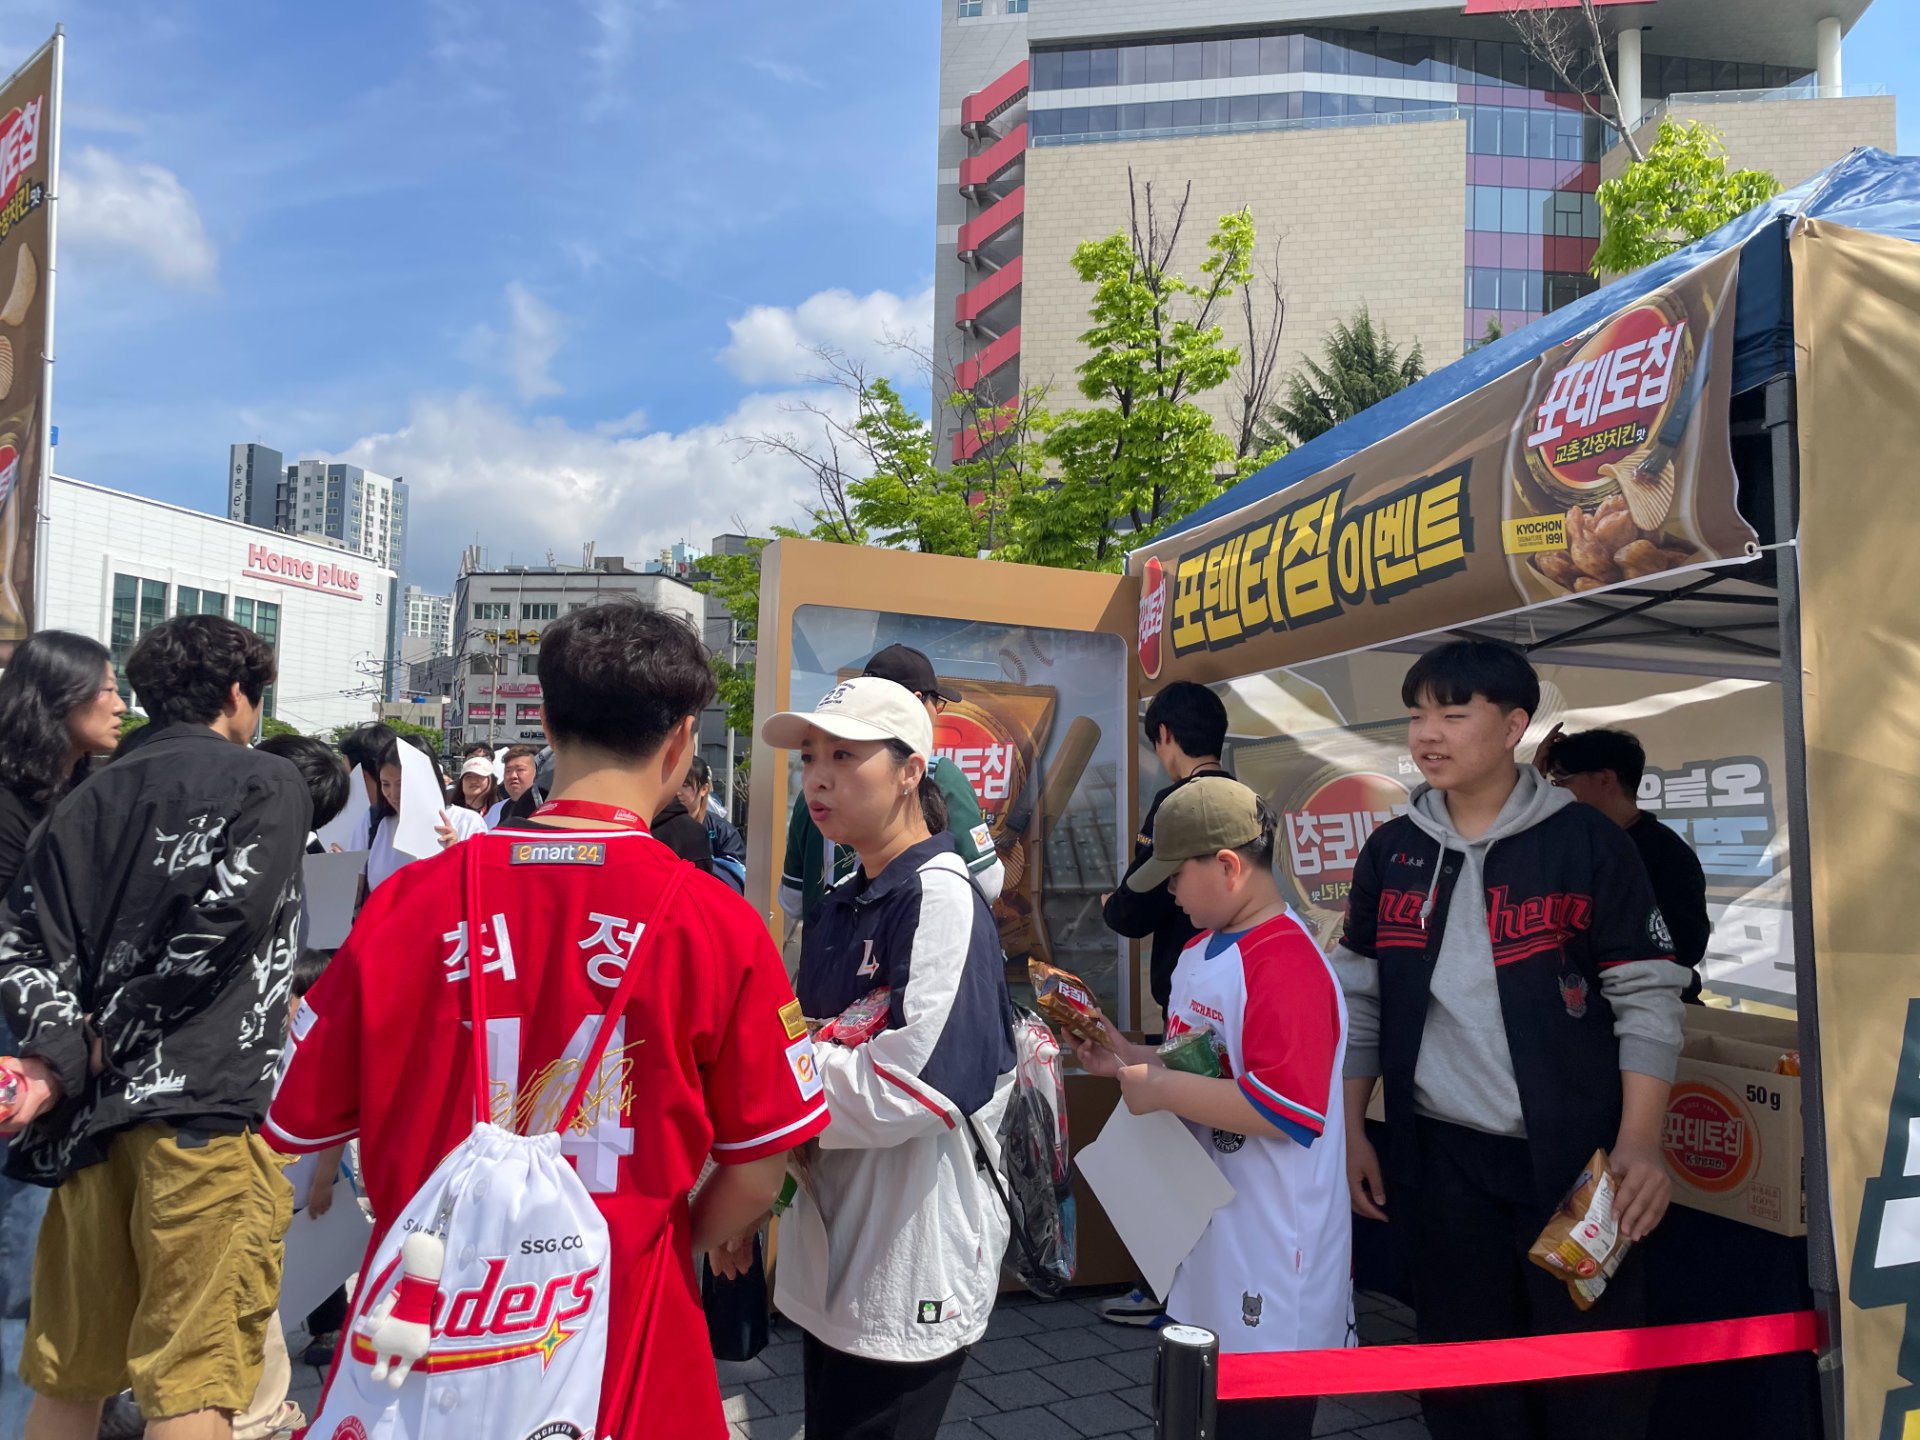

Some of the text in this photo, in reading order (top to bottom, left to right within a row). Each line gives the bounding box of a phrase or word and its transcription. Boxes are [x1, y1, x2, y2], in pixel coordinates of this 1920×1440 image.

[1527, 322, 1685, 447] 포테토칩
[1337, 475, 1464, 594] 이벤트
[1516, 520, 1562, 535] KYOCHON
[1546, 533, 1563, 545] 1991
[248, 543, 360, 591] Home plus
[1663, 1111, 1744, 1158] 포테토칩
